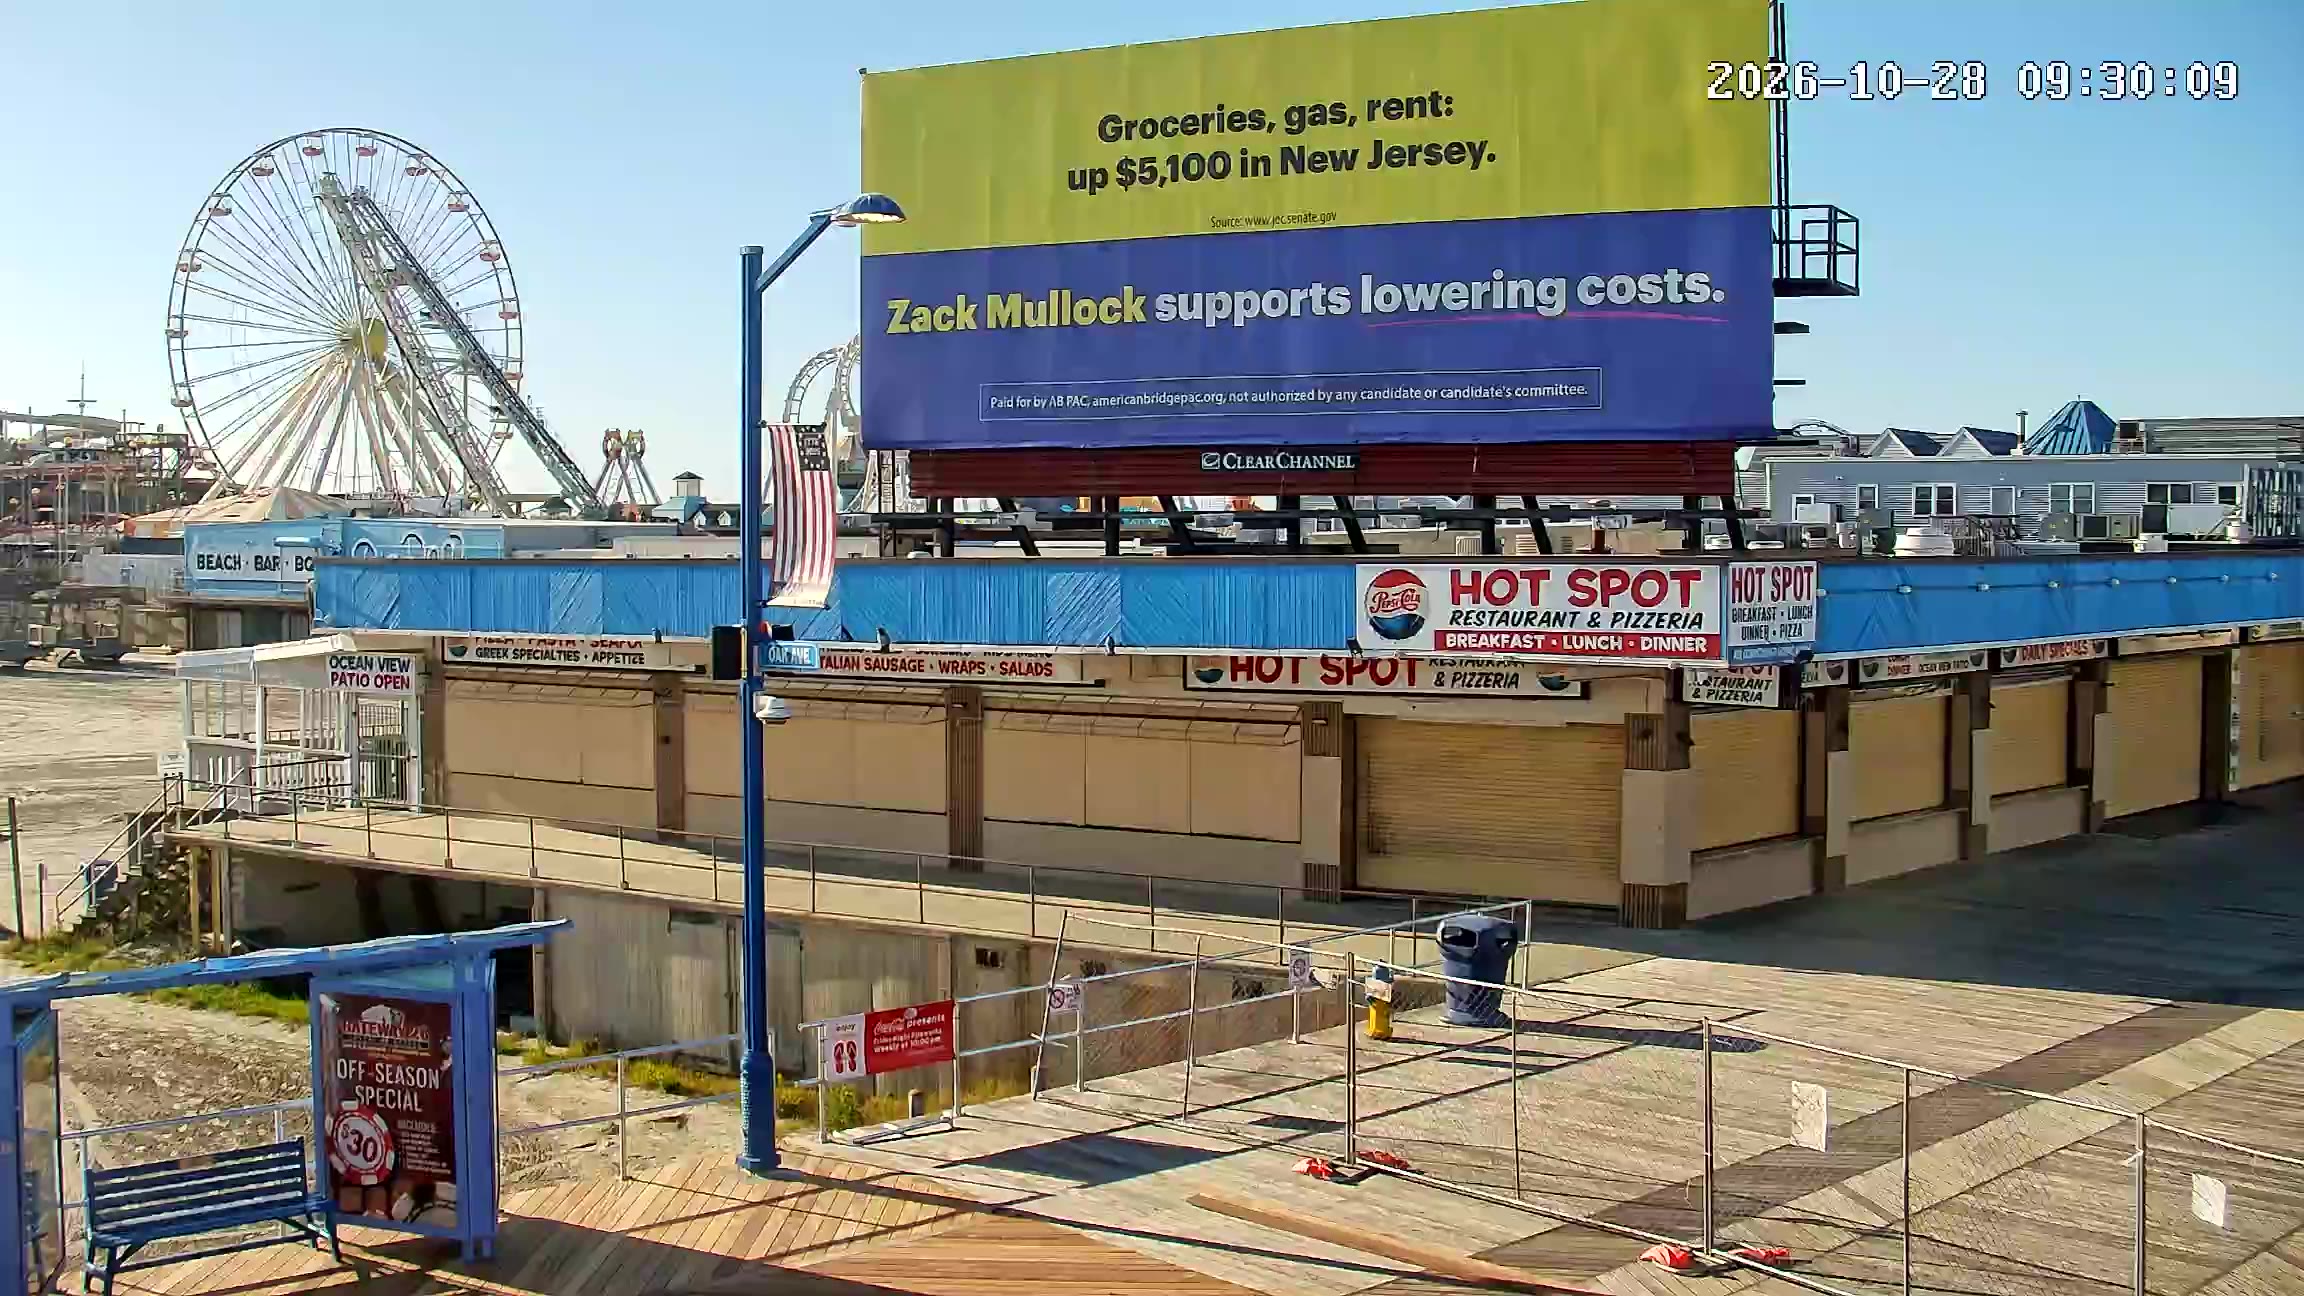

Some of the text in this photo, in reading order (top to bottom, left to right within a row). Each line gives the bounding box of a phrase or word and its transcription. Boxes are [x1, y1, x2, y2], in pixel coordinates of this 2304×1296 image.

[1097, 90, 1453, 143] Groceries, gas, rent:
[1068, 138, 1496, 196] up $5,100 in New Jersey.
[1210, 216, 1242, 228] Source:
[887, 268, 1725, 334] Zack Mullock supports lowering costs.
[990, 396, 1014, 409] Paid
[1016, 396, 1032, 408] for
[1033, 396, 1047, 410] by
[1049, 395, 1064, 408] AB
[1228, 392, 1249, 403] not
[1251, 389, 1315, 403] authorized
[1317, 389, 1333, 403] by
[1335, 391, 1358, 403] any
[1360, 387, 1421, 400] candidate
[1424, 389, 1437, 399] or
[1440, 384, 1512, 399] candidate's
[1514, 383, 1589, 397] committee.
[197, 554, 241, 571] BEACH
[254, 555, 280, 571] BAR
[1450, 568, 1702, 609] HOT SPOT
[1732, 566, 1813, 603] HOT SPOT
[1449, 609, 1703, 630] RESTAURANT & PIZZERIA
[1732, 605, 1813, 623] BREAKFAST LUNCH
[1741, 623, 1803, 640] DINNER PIZZA
[1446, 633, 1708, 653] BREAKFAST LUNCH DINNER
[329, 656, 410, 672] OCEAN VIEW
[476, 647, 509, 660] GREEK
[512, 648, 580, 662] SPECIALTIES
[864, 657, 925, 673] SAUSAGE
[938, 659, 986, 675] WRAPS
[1000, 660, 1053, 677] SALADS
[1230, 656, 1417, 686] HOT SPOT
[331, 672, 410, 690] PATIO OPEN
[1434, 672, 1519, 689] & PIZZERIA
[1692, 688, 1763, 702] & PIZZERIA
[355, 1085, 423, 1113] SPECIAL
